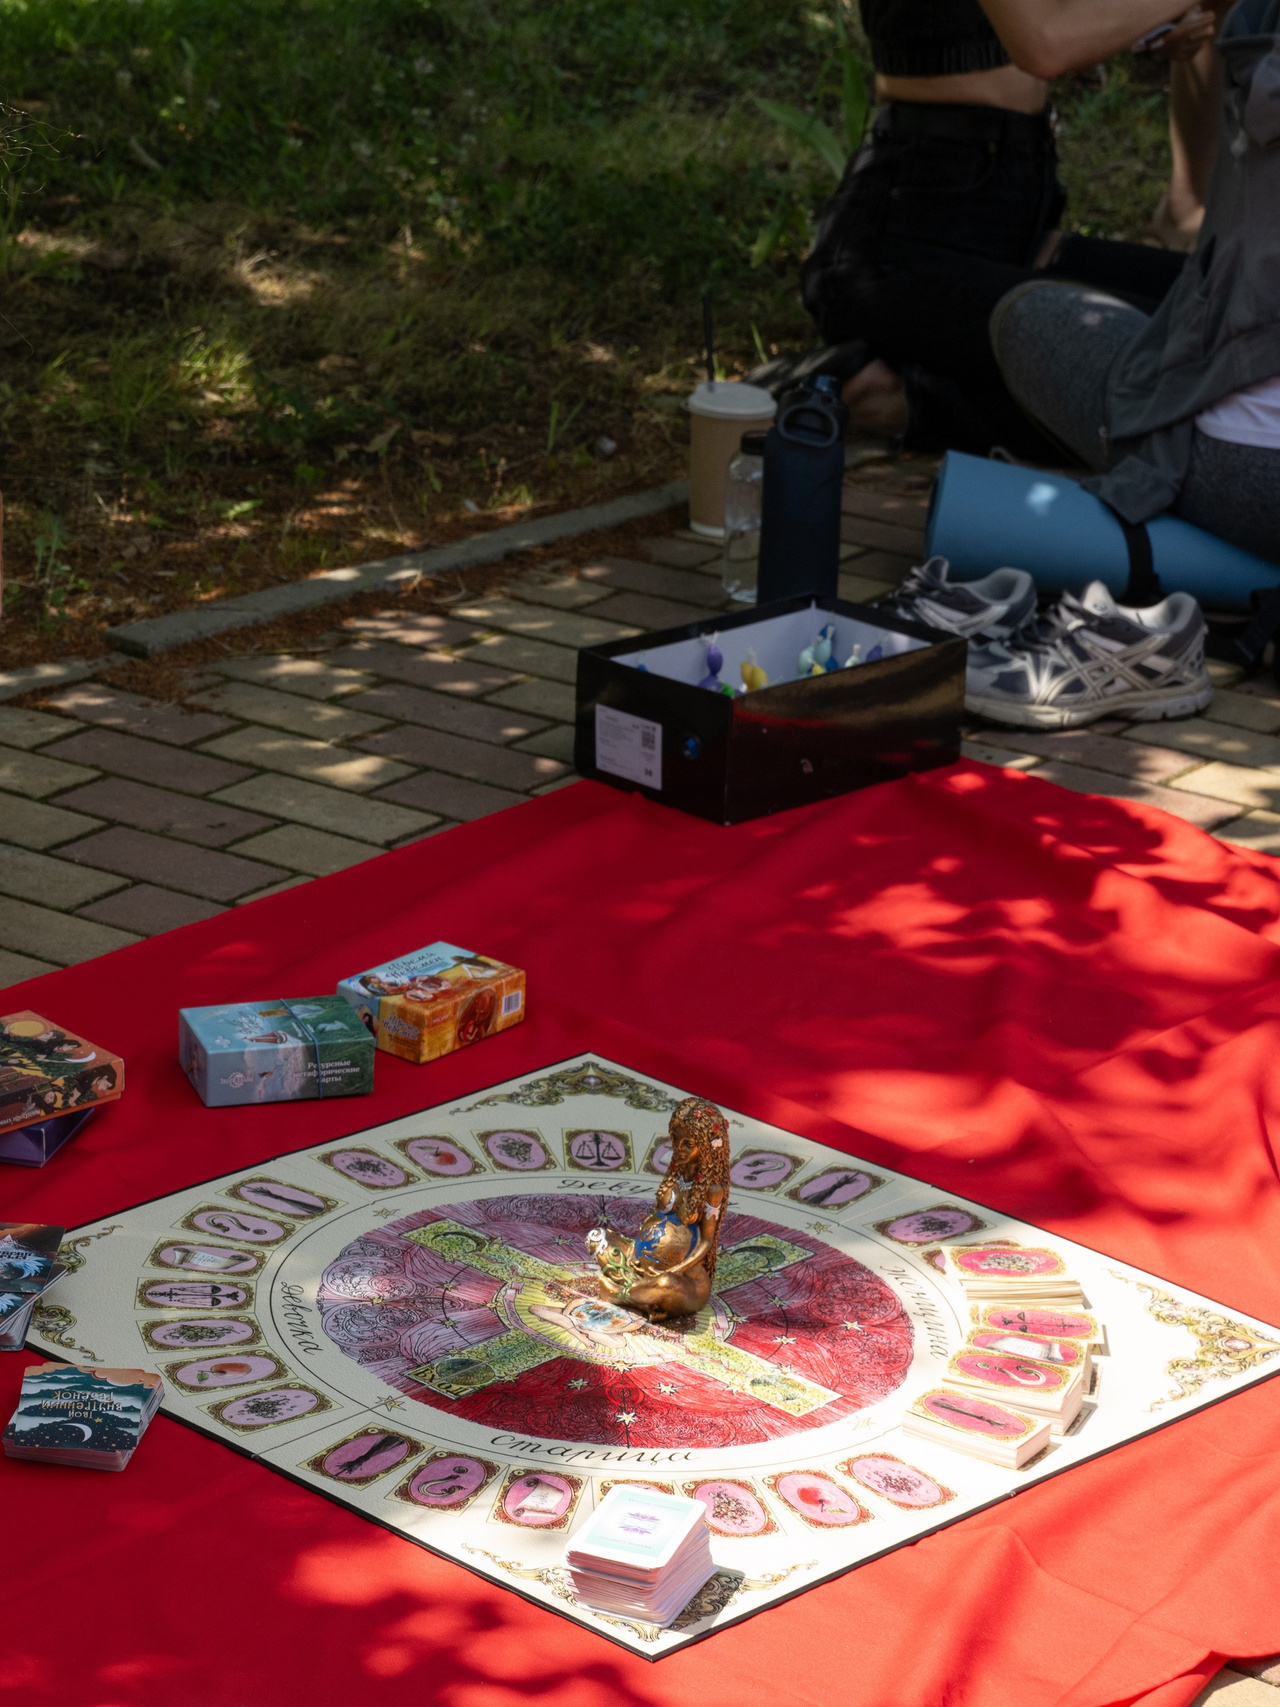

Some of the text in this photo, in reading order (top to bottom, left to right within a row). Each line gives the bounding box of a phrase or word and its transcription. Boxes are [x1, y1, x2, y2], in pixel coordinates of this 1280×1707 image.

[307, 1060, 351, 1069] Реурсные
[281, 1282, 324, 1356] Девочка
[880, 1265, 949, 1360] Женщина
[68, 1410, 93, 1419] ТВОЙ
[490, 1434, 696, 1466] Старица
